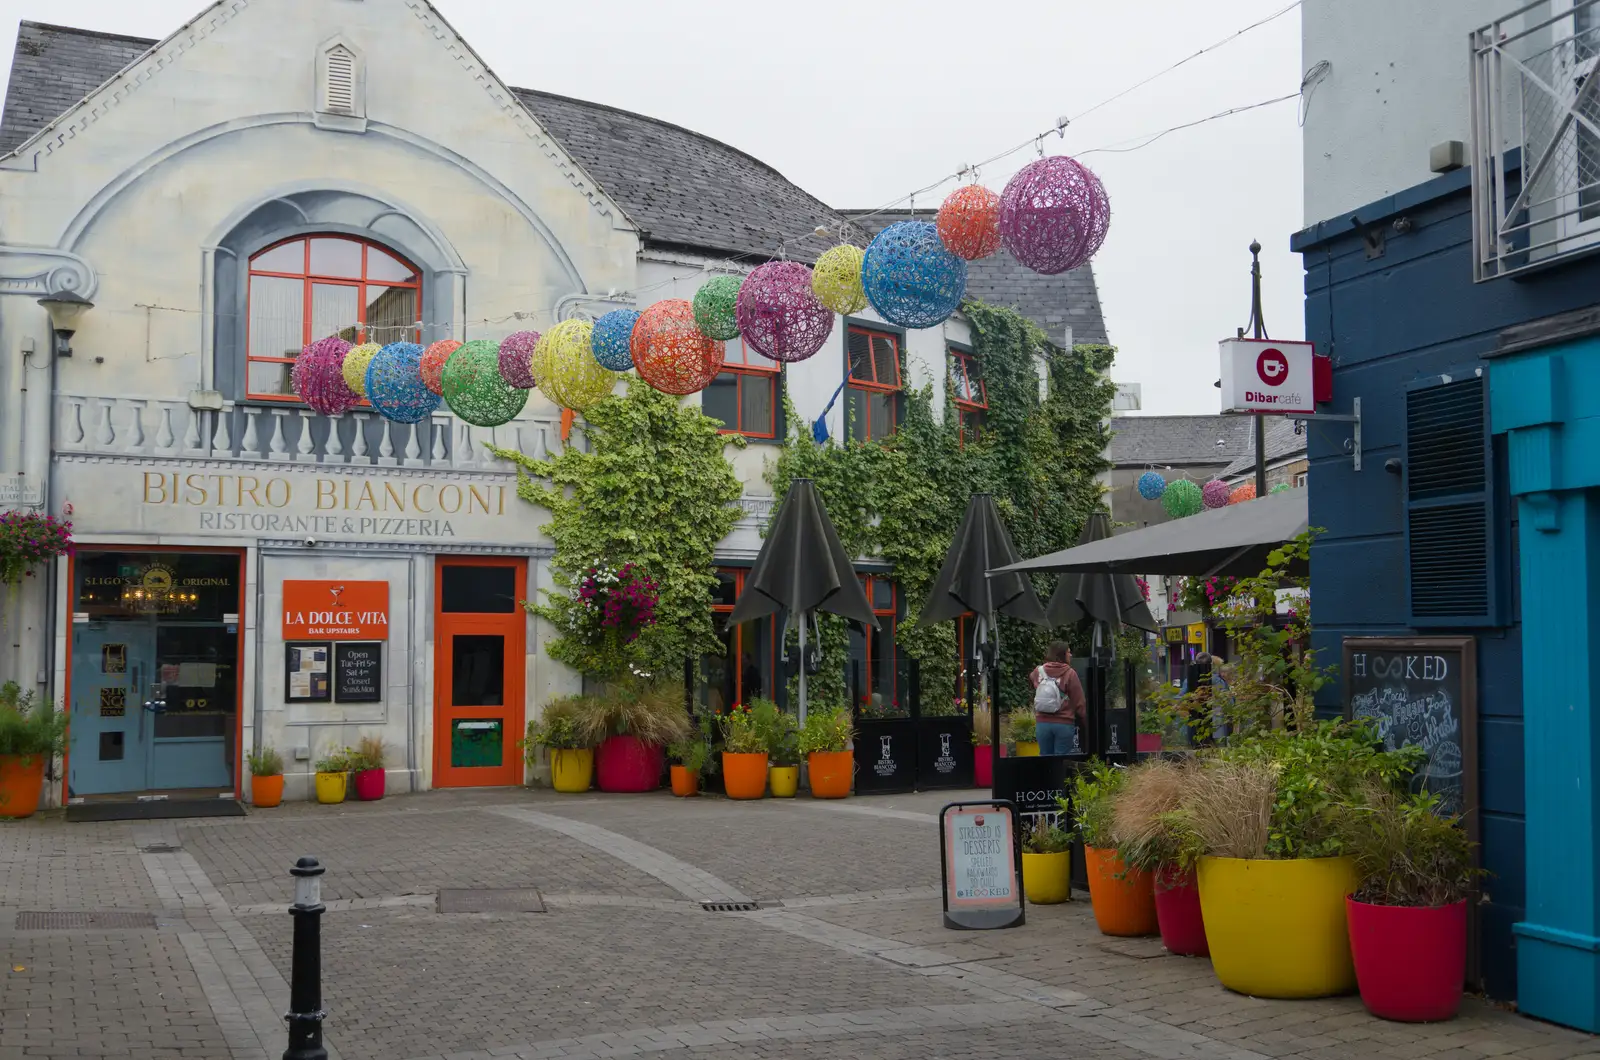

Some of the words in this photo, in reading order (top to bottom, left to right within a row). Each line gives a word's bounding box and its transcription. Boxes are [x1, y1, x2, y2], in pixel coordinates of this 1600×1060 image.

[1245, 391, 1302, 405] Dibarcafé
[143, 471, 292, 508] BISTRO
[316, 478, 506, 516] BIANCONI
[199, 511, 336, 534] RISTORANTE
[341, 515, 355, 534] &
[360, 516, 455, 537] PIZZERIA
[84, 576, 131, 586] SLIGO'S
[182, 577, 230, 587] ORIGINAL
[285, 611, 305, 625] LA
[308, 611, 353, 625] DOLCE
[356, 611, 388, 625] VITA
[308, 627, 324, 635] BAR
[326, 627, 360, 635] UPSTAIRS
[347, 650, 368, 660] Open
[340, 659, 366, 668] Tue-Fri
[345, 668, 357, 677] Sat
[346, 677, 371, 685] Closed
[1015, 789, 1063, 803] HOOKE
[958, 826, 992, 840] STRESSED
[994, 825, 1001, 839] IS
[964, 840, 1001, 856] DESSERTS
[970, 857, 993, 868] SPELLED
